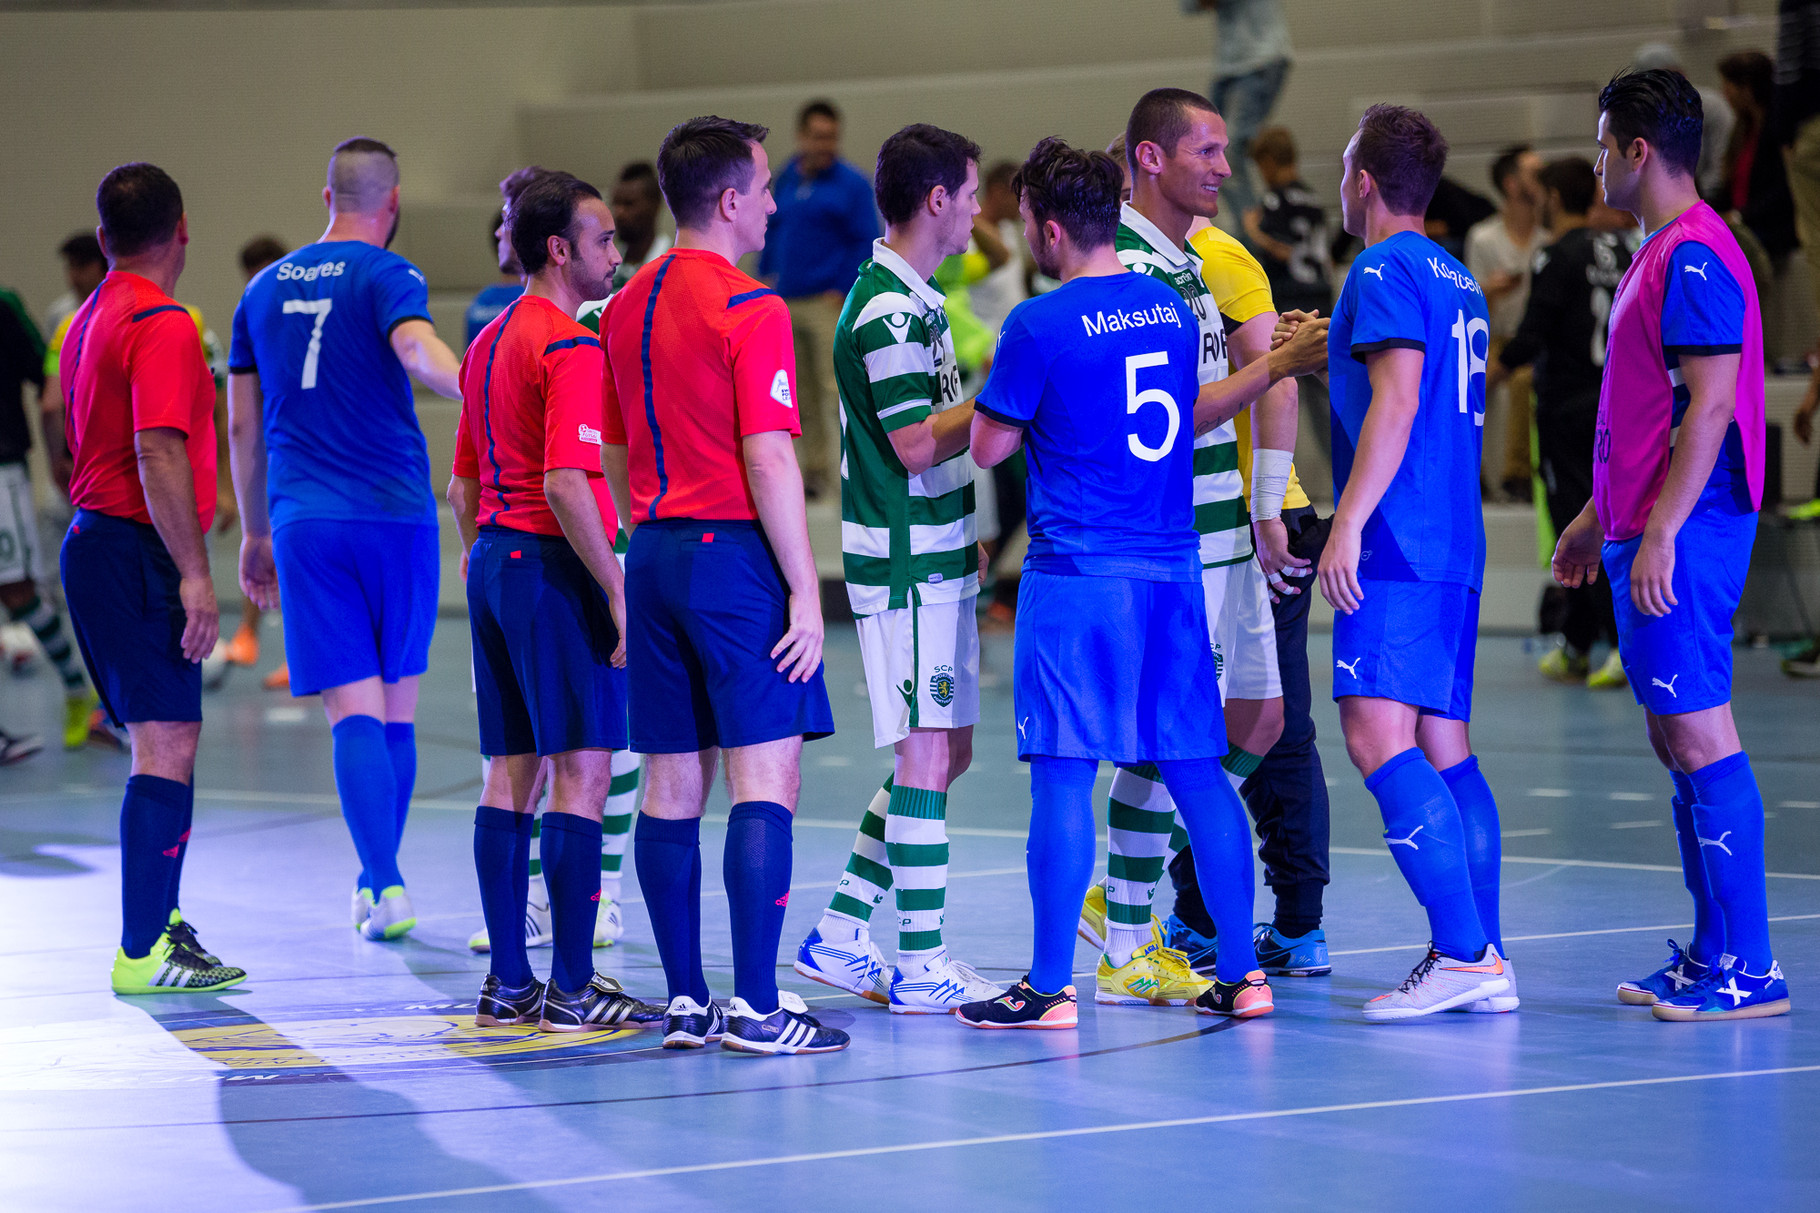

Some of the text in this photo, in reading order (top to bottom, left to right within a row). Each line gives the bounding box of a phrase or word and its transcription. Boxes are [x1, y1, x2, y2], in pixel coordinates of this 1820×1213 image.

[276, 260, 346, 282] Soares
[282, 297, 333, 390] 7
[1081, 302, 1182, 337] Maksutaj
[1451, 308, 1490, 427] 18
[1125, 350, 1181, 462] 5
[934, 664, 953, 673] SCP
